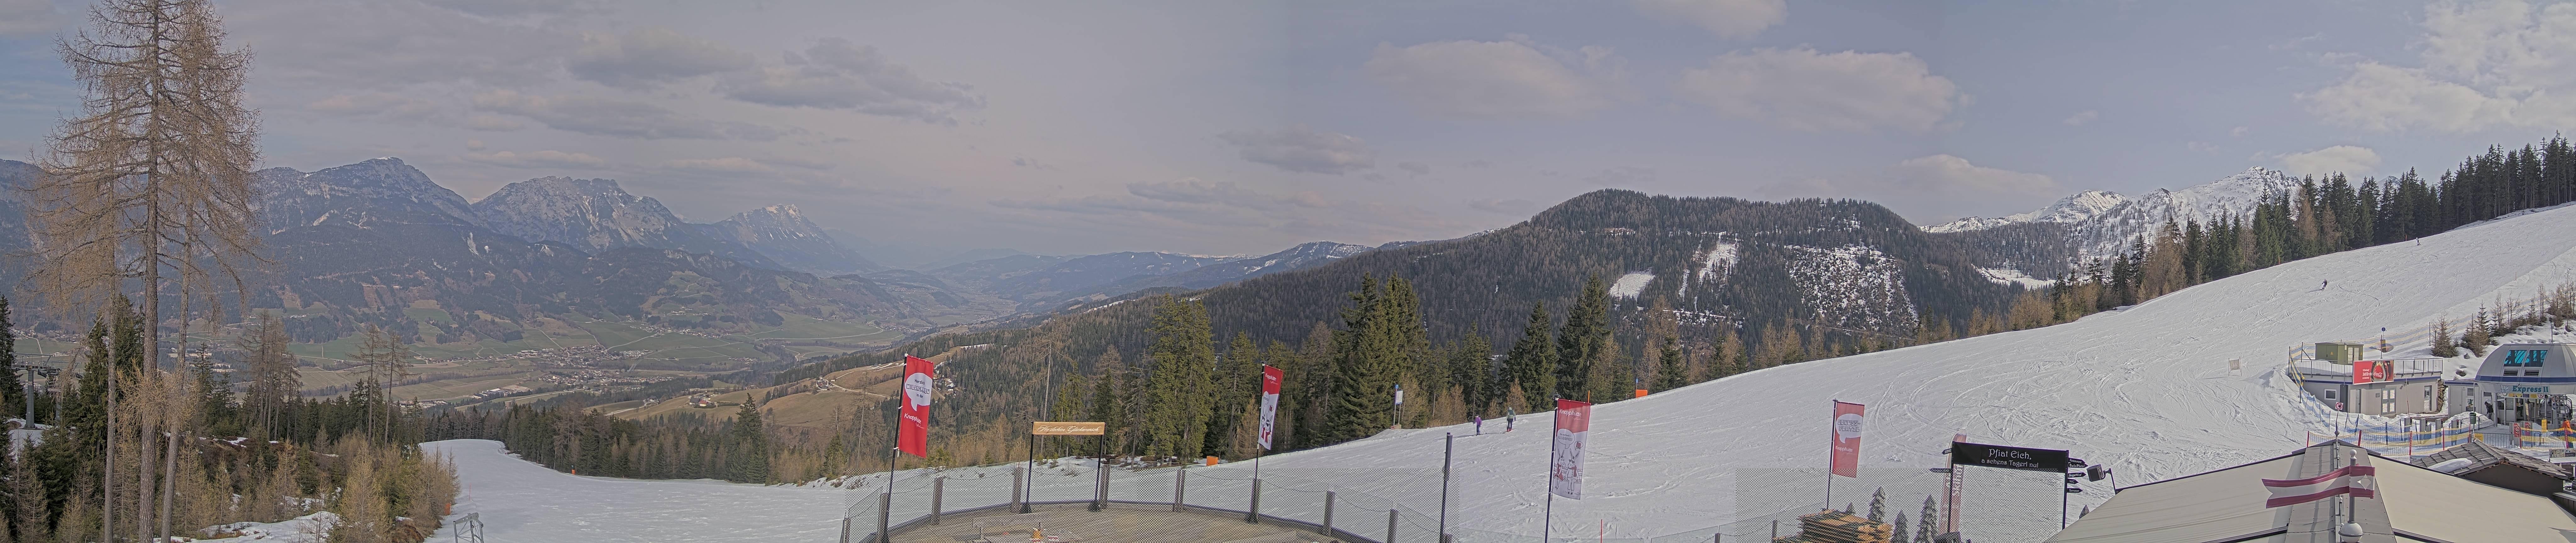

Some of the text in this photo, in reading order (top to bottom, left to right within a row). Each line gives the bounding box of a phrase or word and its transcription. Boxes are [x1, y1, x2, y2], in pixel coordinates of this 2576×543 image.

[2512, 385, 2542, 393] Express
[1989, 448, 2032, 460] Pfiat Eich,
